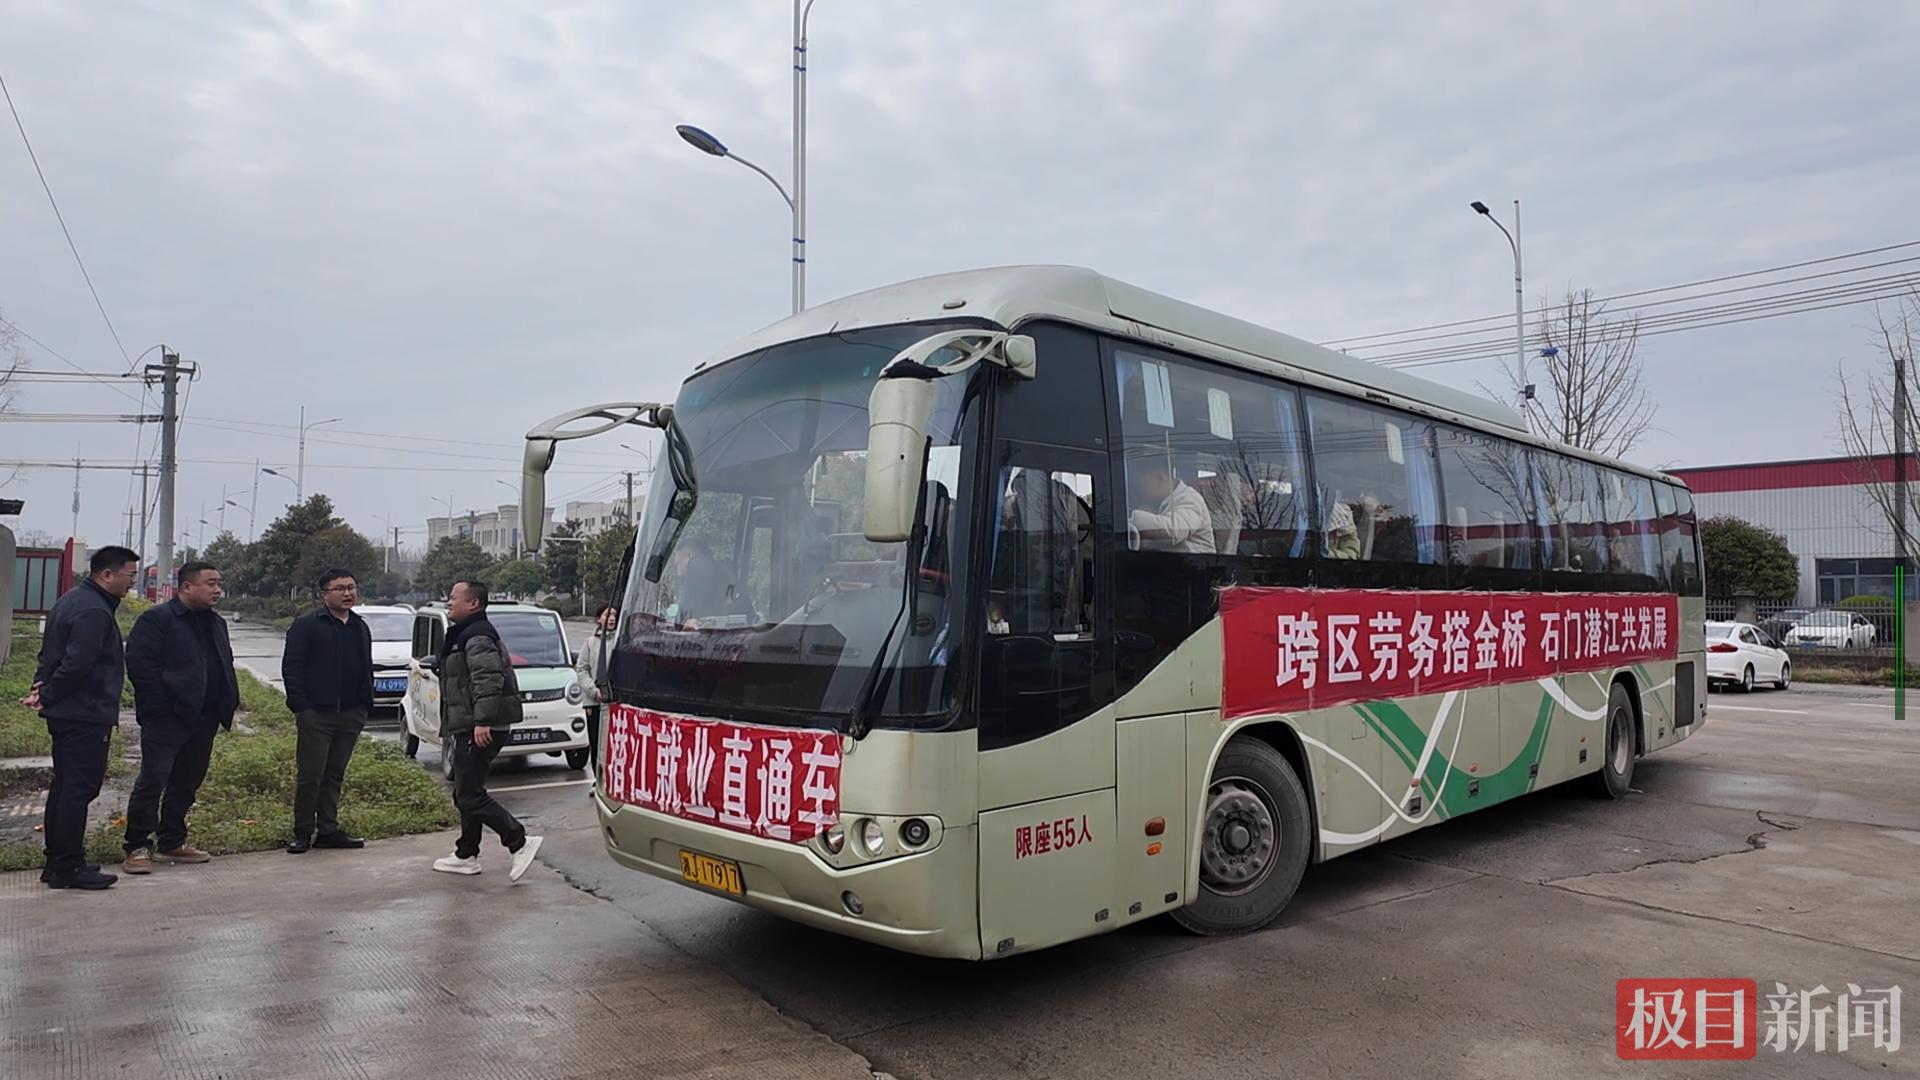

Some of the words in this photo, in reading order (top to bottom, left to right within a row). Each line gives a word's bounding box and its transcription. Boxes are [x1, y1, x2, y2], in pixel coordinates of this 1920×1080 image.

[1276, 609, 1527, 690] 跨区劳务搭金桥
[1539, 606, 1668, 662] 石门潜江共发展
[608, 710, 841, 840] 潜江就业直通车
[1015, 814, 1093, 860] 限座55人
